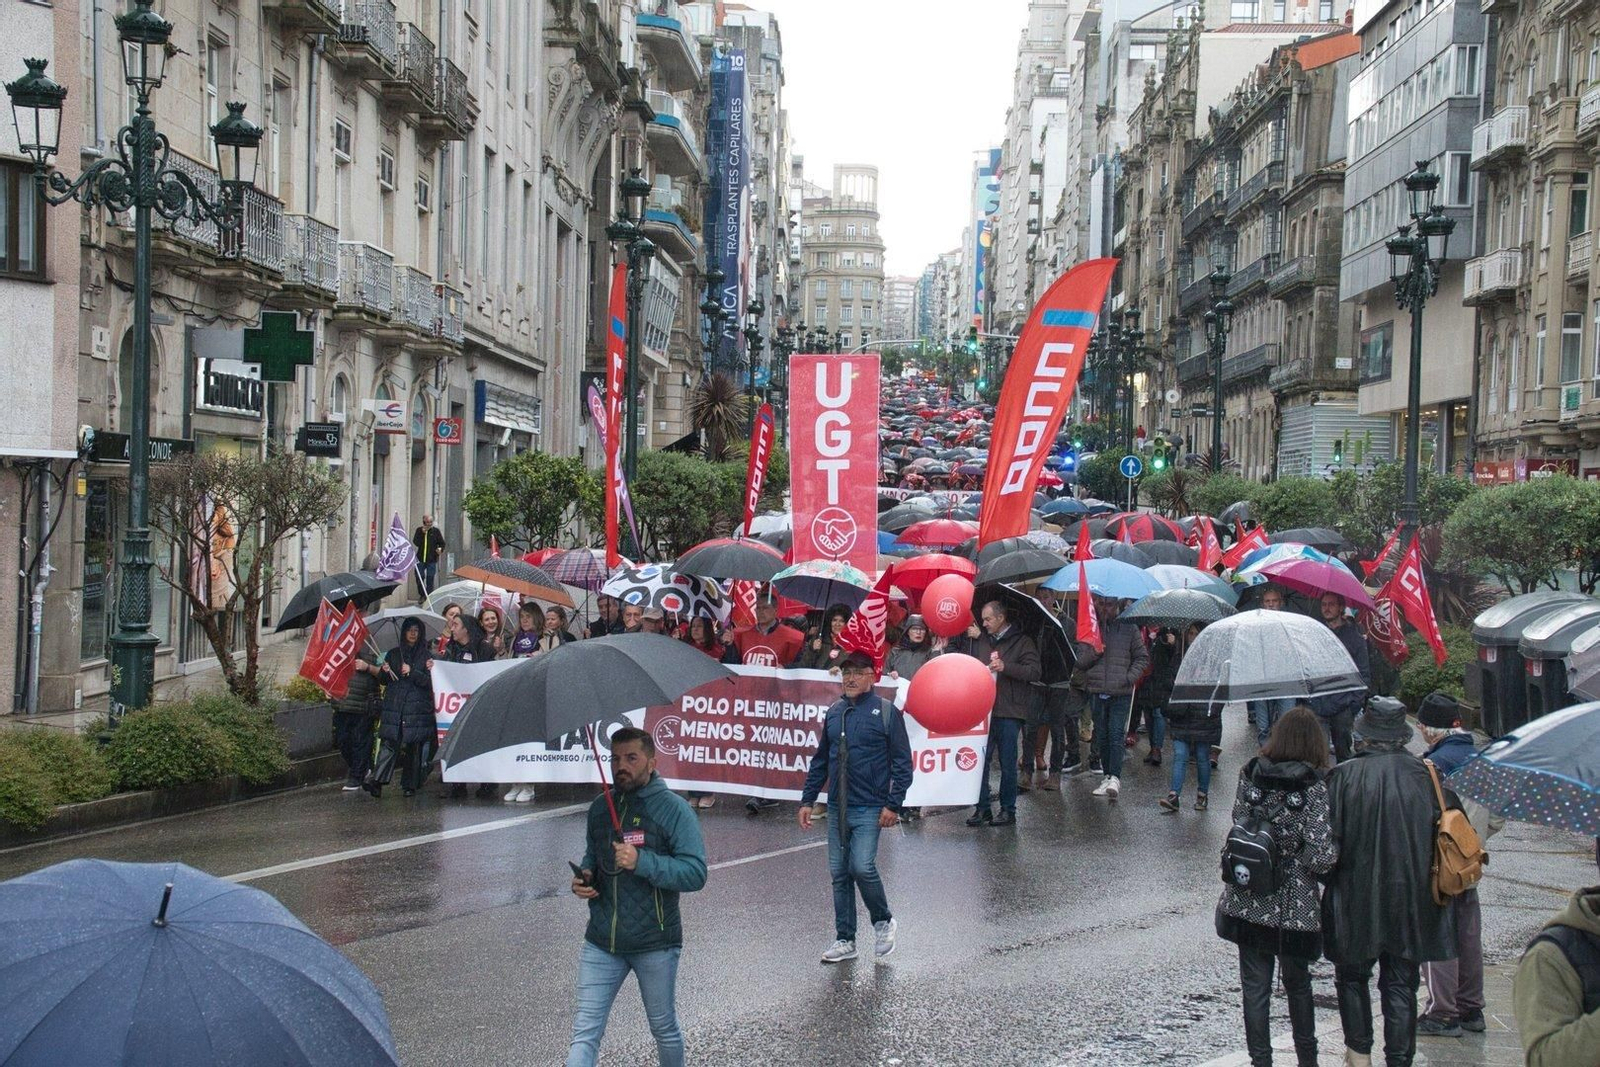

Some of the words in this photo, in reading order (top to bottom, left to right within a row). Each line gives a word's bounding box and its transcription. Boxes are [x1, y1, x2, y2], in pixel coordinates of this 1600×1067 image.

[731, 56, 744, 67] 10
[729, 97, 742, 167] CAPILARES
[727, 168, 740, 258] TRASPLANTES
[815, 362, 852, 505] UGT
[1000, 343, 1075, 495] CCOO
[749, 422, 769, 513] CCOO
[747, 652, 774, 666] UGT
[681, 695, 730, 715] POLO
[733, 699, 781, 719] PLENO
[782, 702, 829, 723] EMPR
[680, 720, 745, 741] MENOS
[750, 725, 819, 749] XORNADA
[516, 754, 580, 762] #PLENOEMPREGO
[678, 745, 765, 769] MELLORES
[766, 754, 813, 773] SALA
